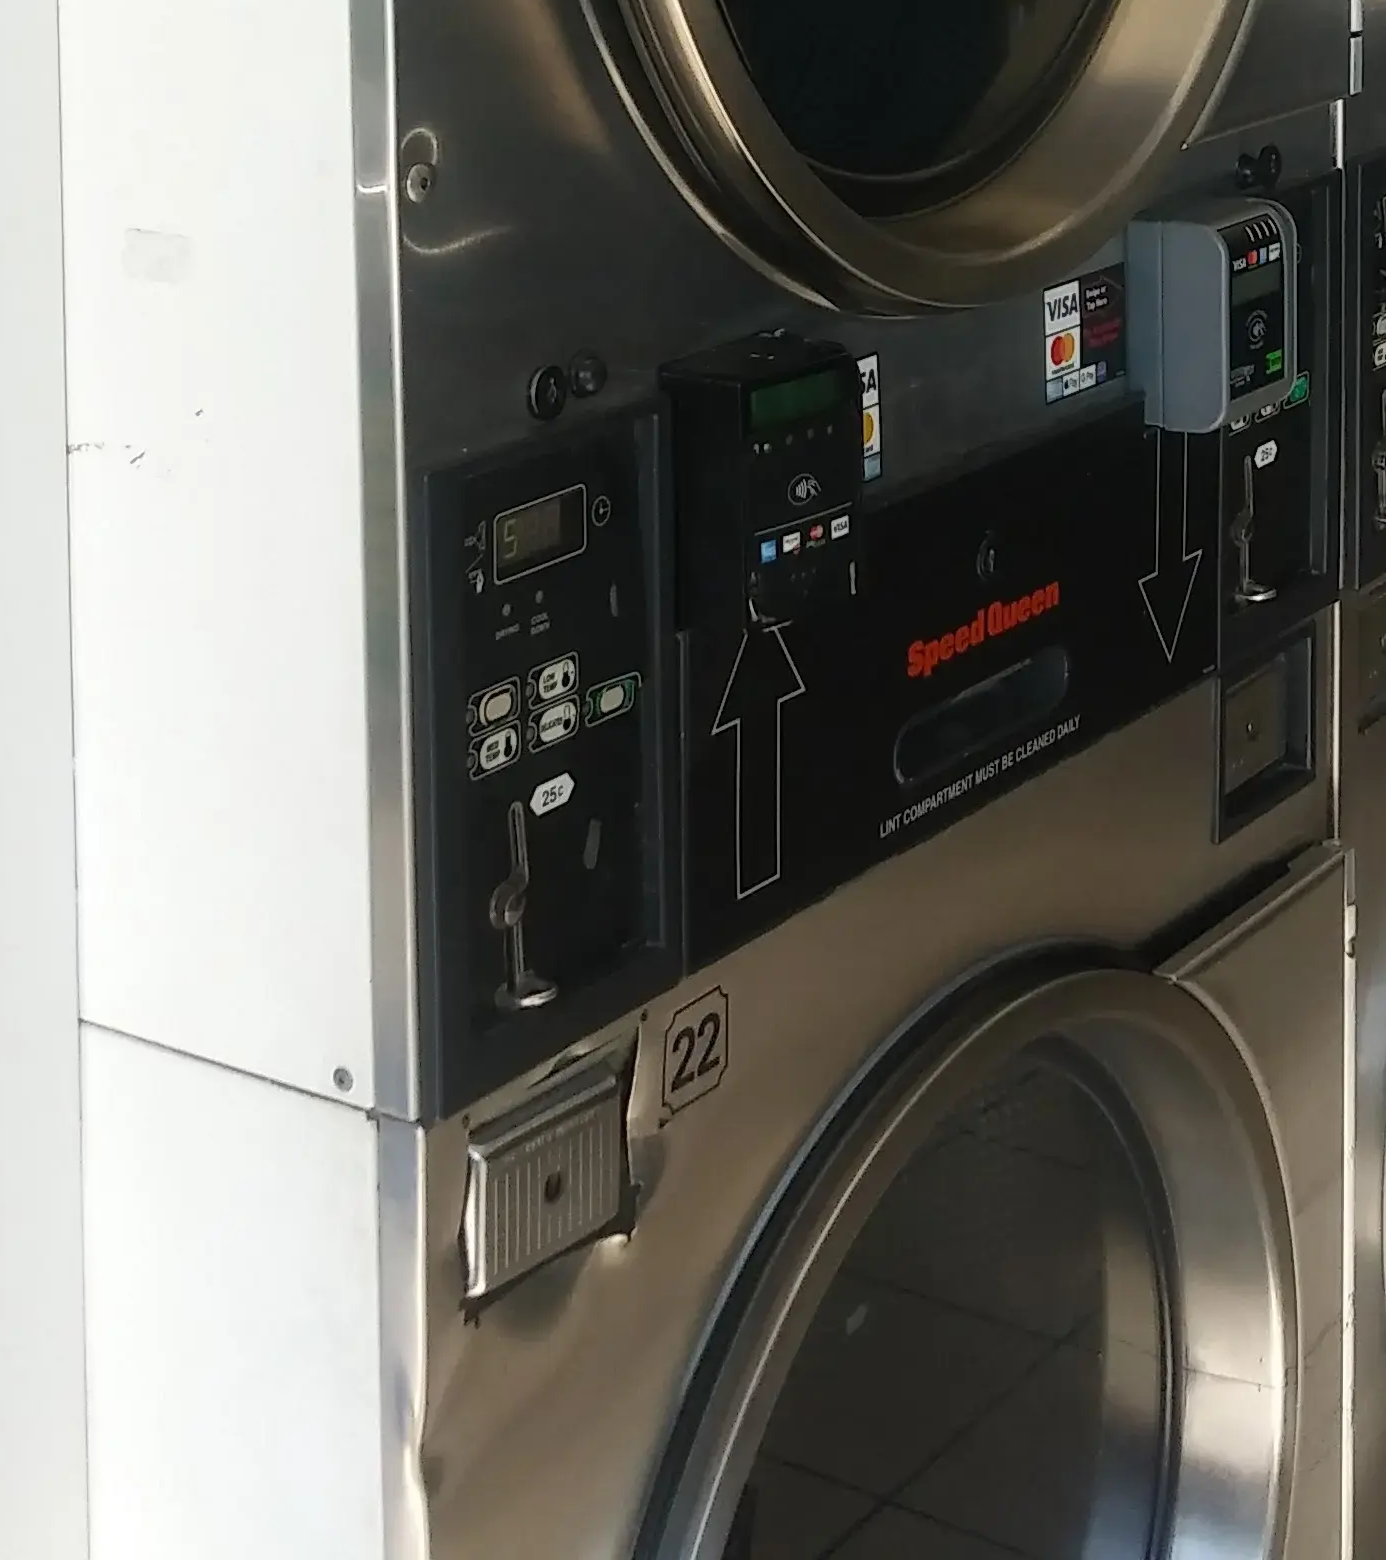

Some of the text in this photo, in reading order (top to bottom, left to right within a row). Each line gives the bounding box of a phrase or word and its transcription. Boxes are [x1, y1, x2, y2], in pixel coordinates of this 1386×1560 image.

[1046, 293, 1078, 322] VISA
[907, 581, 1060, 678] Speed Queen
[542, 672, 556, 685] LOW
[543, 682, 558, 694] TEMP
[540, 716, 563, 733] DELICATES
[486, 740, 500, 752] MED
[485, 750, 500, 763] TEMP
[879, 713, 1082, 839] LINT COMPARTMENT MUST BE CLEANED DAILY
[542, 784, 564, 808] 25¢
[671, 1011, 722, 1093] 22
